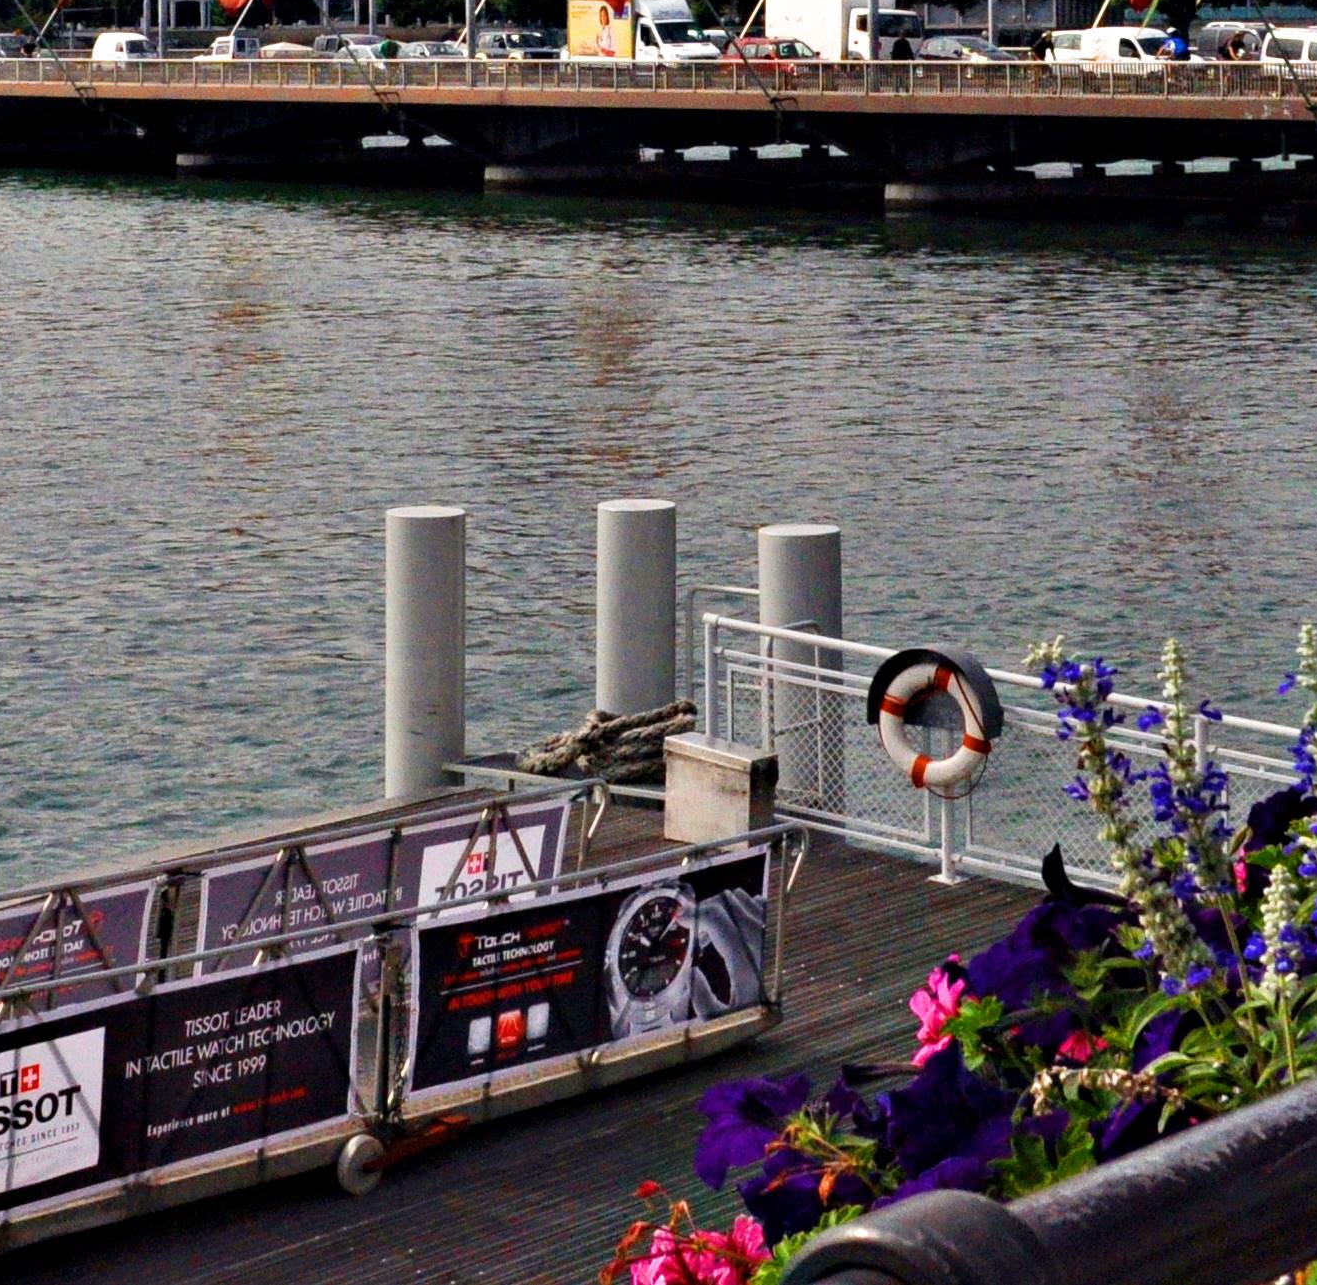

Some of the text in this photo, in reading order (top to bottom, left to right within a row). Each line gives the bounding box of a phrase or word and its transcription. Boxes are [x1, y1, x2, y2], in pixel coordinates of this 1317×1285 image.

[234, 999, 282, 1026] LEADER
[125, 1011, 336, 1079] IN TACTILE WATCH TECHNOLOGY
[192, 1054, 267, 1089] SINCE 1999
[196, 1110, 219, 1124] more
[31, 1128, 57, 1144] SINCE
